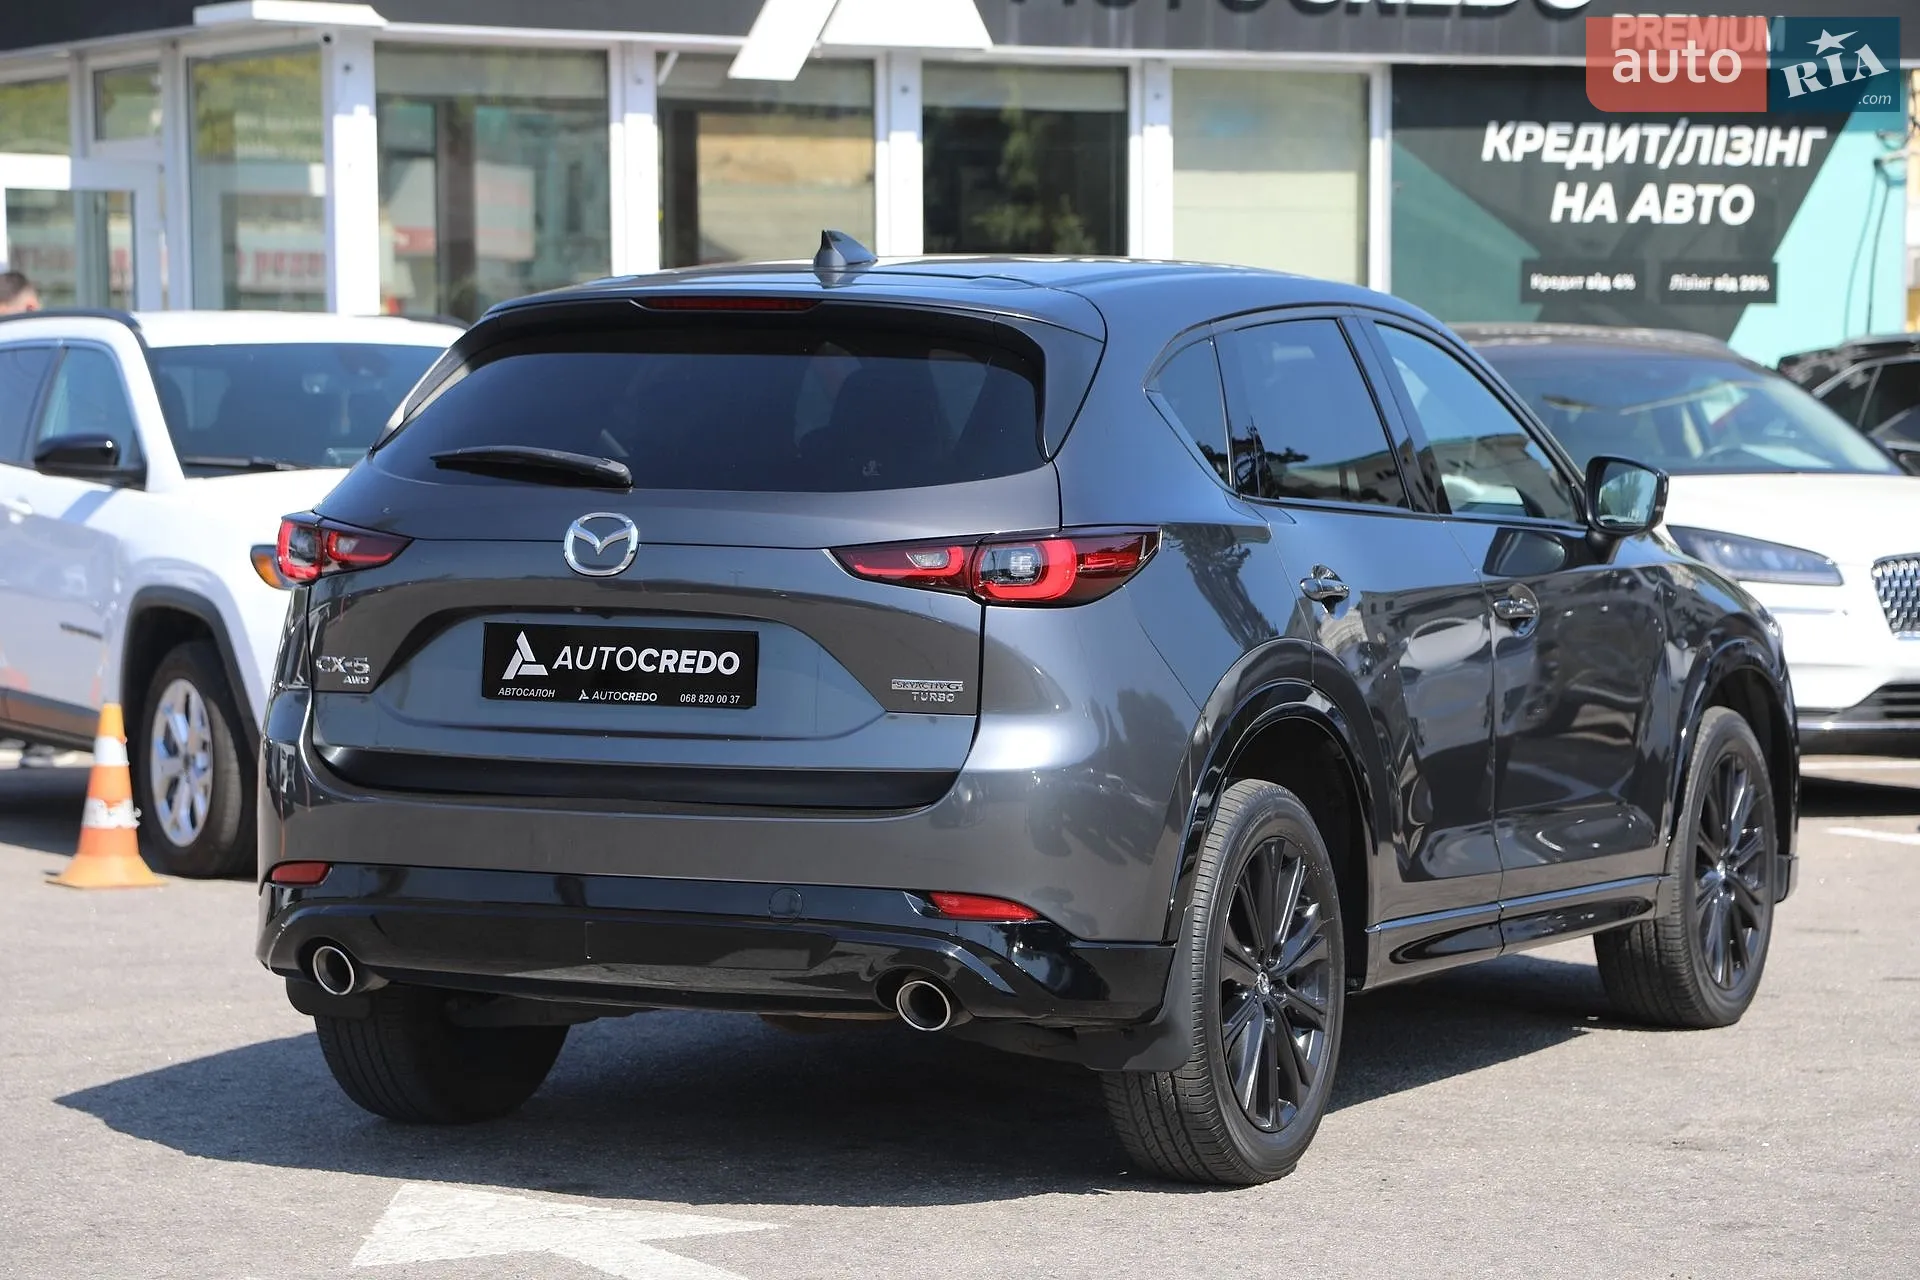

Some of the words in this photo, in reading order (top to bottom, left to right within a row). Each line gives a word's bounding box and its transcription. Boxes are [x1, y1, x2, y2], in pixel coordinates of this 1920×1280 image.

[1611, 13, 1785, 52] PREMIUM
[1481, 119, 1827, 170] КРЕДИТ/ЛІЗІНГ
[1550, 182, 1617, 223] НА
[1626, 183, 1755, 225] АВТО
[315, 655, 370, 673] CX-5
[552, 645, 740, 675] AUTOCREDO
[343, 675, 369, 684] AWD
[498, 687, 555, 698] АВТОСАЛОН
[592, 690, 658, 702] AUTOCREDO
[680, 693, 696, 703] 068
[698, 694, 715, 704] 820
[717, 694, 728, 704] 00
[729, 695, 740, 704] 37
[912, 691, 955, 703] TURBO
